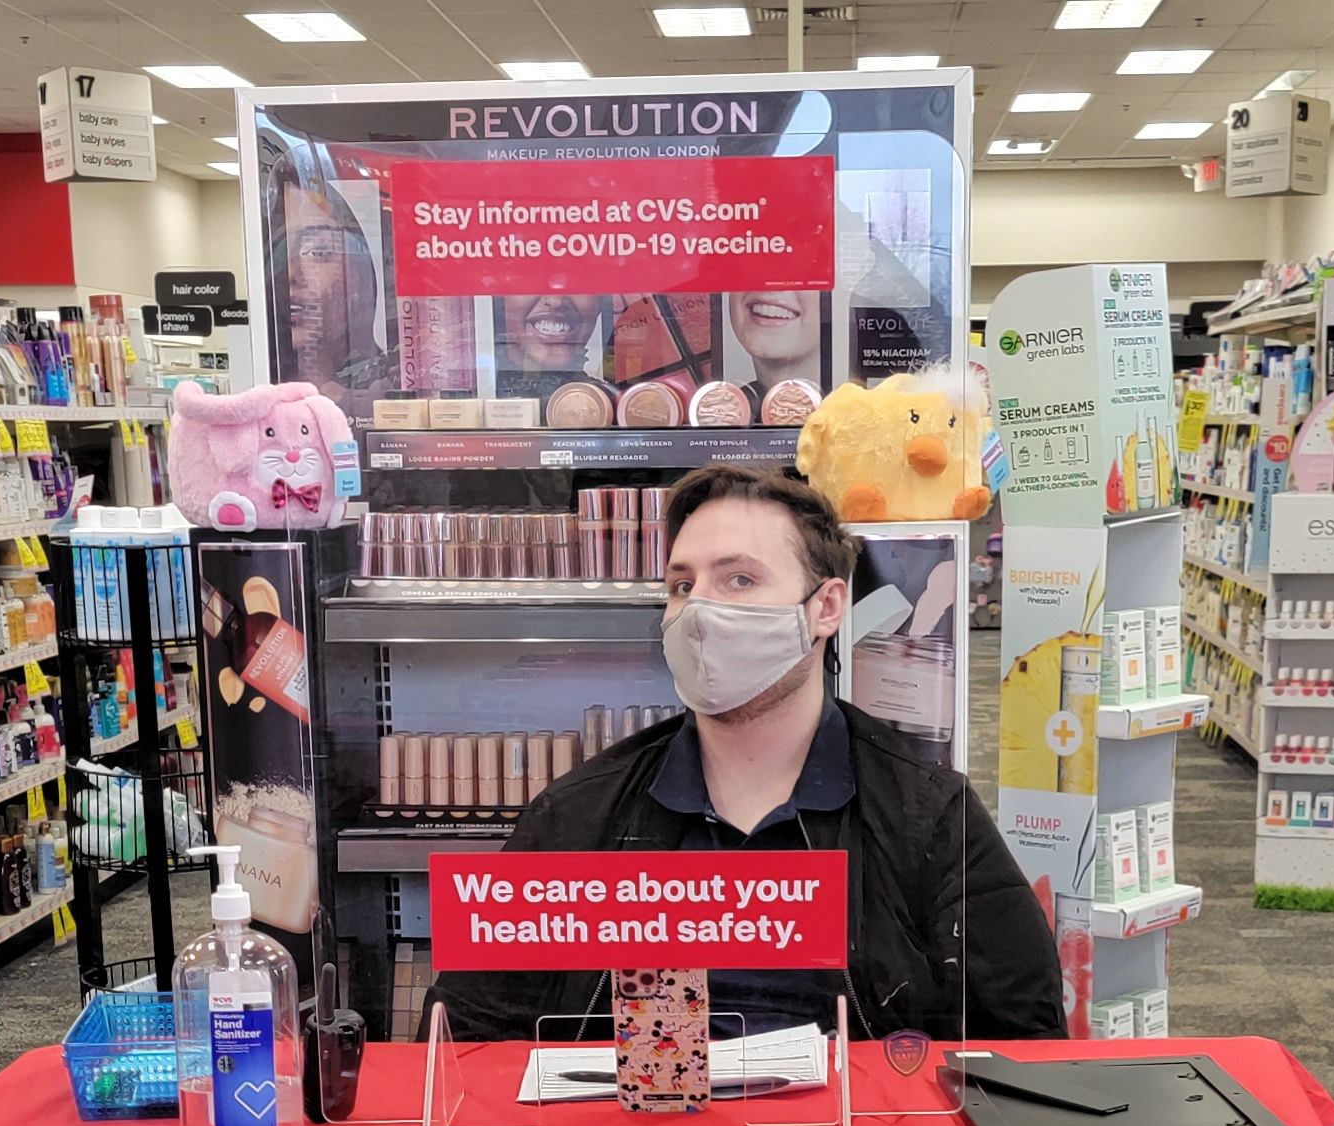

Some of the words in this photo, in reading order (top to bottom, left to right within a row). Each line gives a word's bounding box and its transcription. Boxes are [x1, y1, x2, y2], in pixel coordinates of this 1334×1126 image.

[75, 75, 95, 98] 17
[79, 112, 99, 126] baby
[101, 117, 118, 125] care
[449, 101, 758, 139] REVOLUTION
[1231, 108, 1250, 130] 20
[81, 133, 100, 146] baby
[103, 136, 126, 147] wipes
[83, 153, 102, 166] baby
[104, 156, 133, 168] diapers
[487, 149, 548, 160] MAKEUP
[556, 146, 651, 159] REVOLUTION
[658, 145, 720, 157] LONDON
[414, 201, 472, 231] Stay
[477, 198, 600, 226] informed
[605, 201, 632, 223] at
[415, 234, 493, 259] about
[497, 234, 542, 257] the
[547, 232, 677, 257] COVID-19
[681, 230, 793, 255] vaccine.
[1110, 273, 1152, 287] GARNIER
[172, 284, 192, 294] hair
[194, 284, 220, 294] color
[1104, 311, 1129, 323] SERUM
[1132, 309, 1163, 321] CREAMS
[163, 322, 189, 331] shave
[403, 300, 415, 389] VOLUTIO
[1000, 328, 1084, 350] GARNIER
[1027, 350, 1059, 361] green
[1061, 345, 1085, 355] labs
[1000, 407, 1041, 420] SERUM
[1045, 401, 1095, 415] CREAMS
[1020, 426, 1067, 437] PRODUCTS
[1018, 476, 1039, 484] WEEK
[1081, 479, 1098, 488] SKIN
[1009, 569, 1081, 585] BRIGHTEN
[249, 627, 288, 681] REVOLUTION
[1016, 815, 1060, 831] PLUMP
[453, 873, 514, 903] We
[522, 878, 607, 902] care
[616, 872, 725, 902] about
[733, 878, 820, 911] your
[471, 914, 589, 943] health
[598, 913, 668, 942] and
[677, 913, 803, 949] safety.
[214, 1020, 243, 1029] Hand
[214, 1030, 262, 1039] Sanitizer
